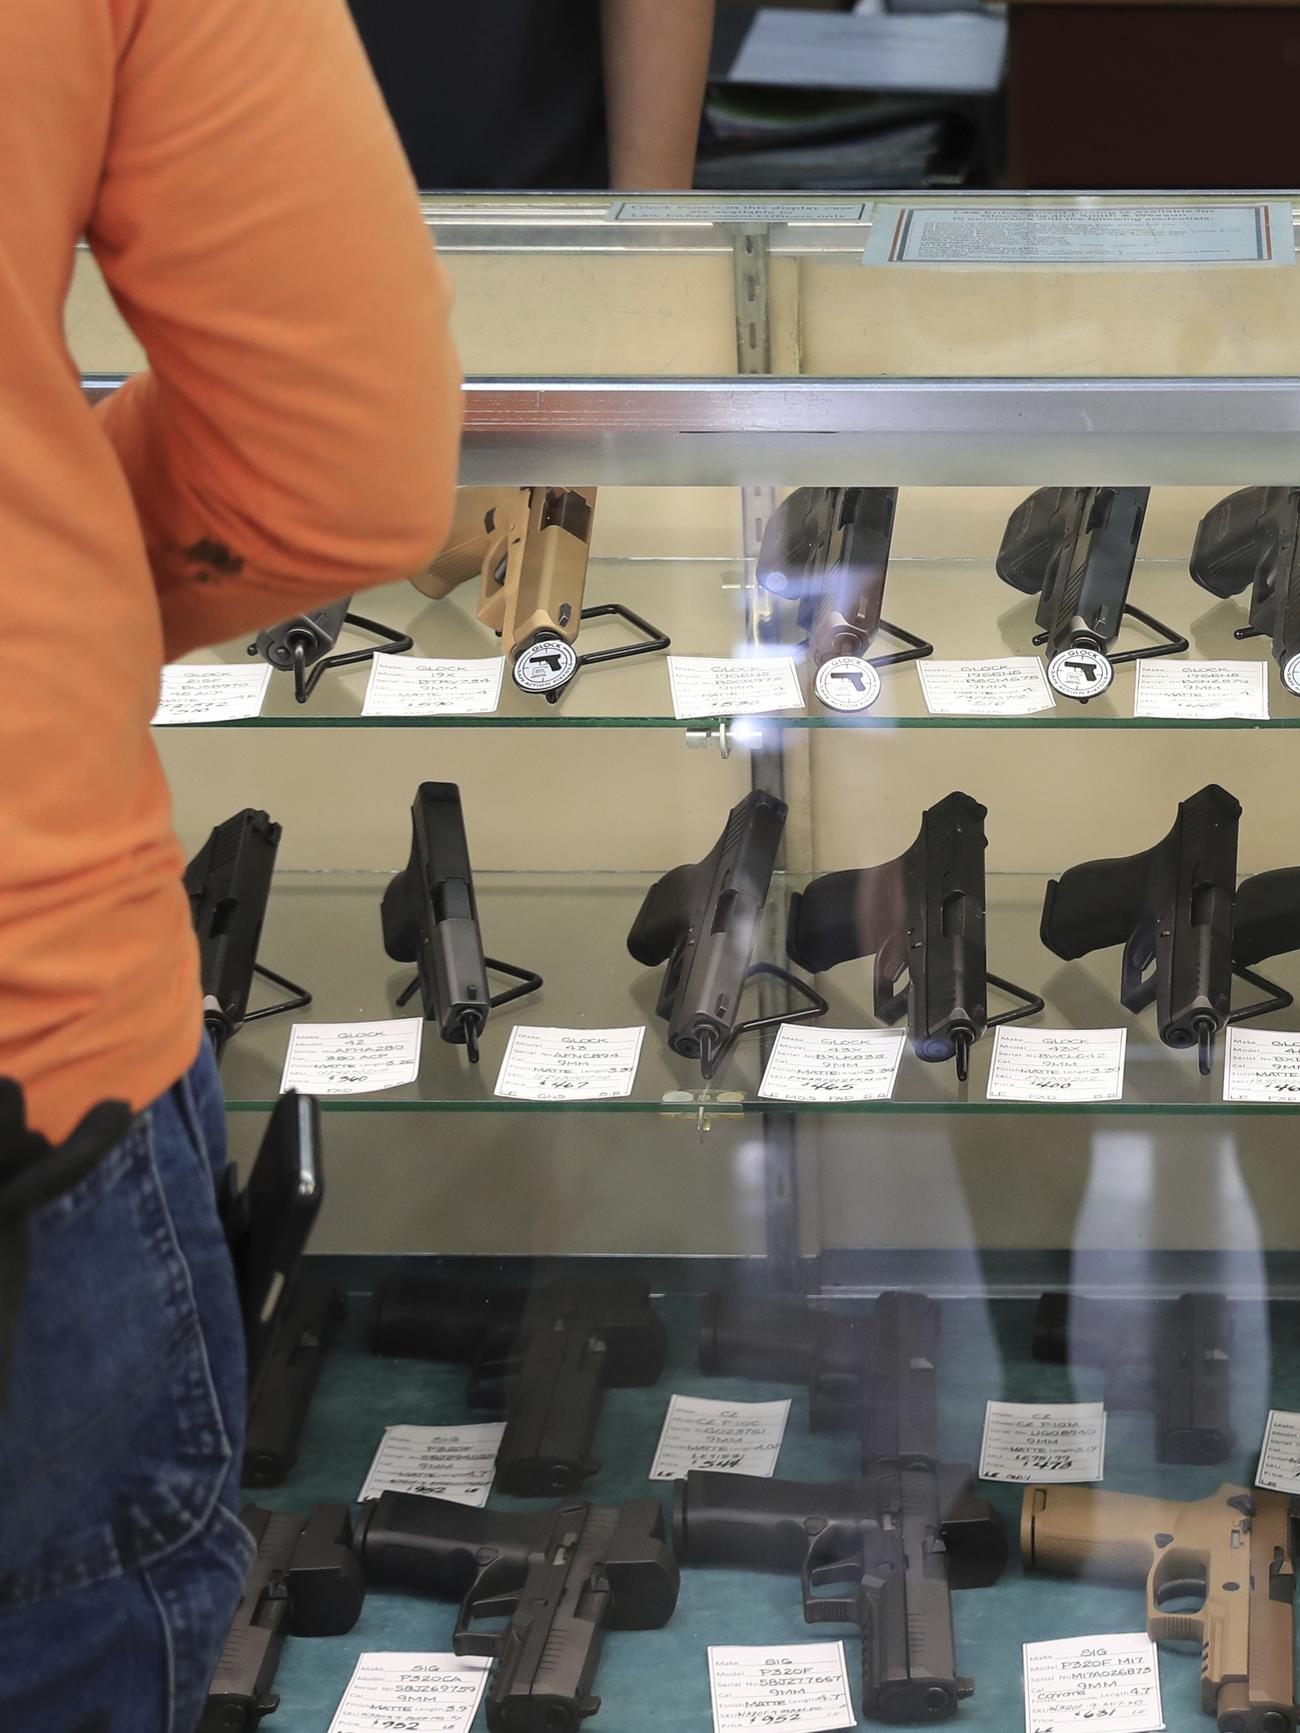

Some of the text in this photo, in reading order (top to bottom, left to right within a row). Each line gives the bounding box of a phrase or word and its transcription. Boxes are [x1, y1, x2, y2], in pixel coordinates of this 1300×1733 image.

[531, 642, 561, 652] GLOCK
[1067, 649, 1098, 659] GLOCK
[337, 1031, 386, 1039] GLOCK
[1080, 1648, 1108, 1658] SIG
[765, 1658, 793, 1666] SIG
[1061, 1658, 1112, 1670] P320F
[1118, 1657, 1143, 1665] M17
[760, 1667, 814, 1676] P320F
[1077, 1680, 1118, 1690] 9MM
[769, 1688, 807, 1696] 9MM
[1037, 1690, 1086, 1700] COYOTE
[370, 1704, 412, 1712] MATTE
[745, 1700, 787, 1708] MATTE
